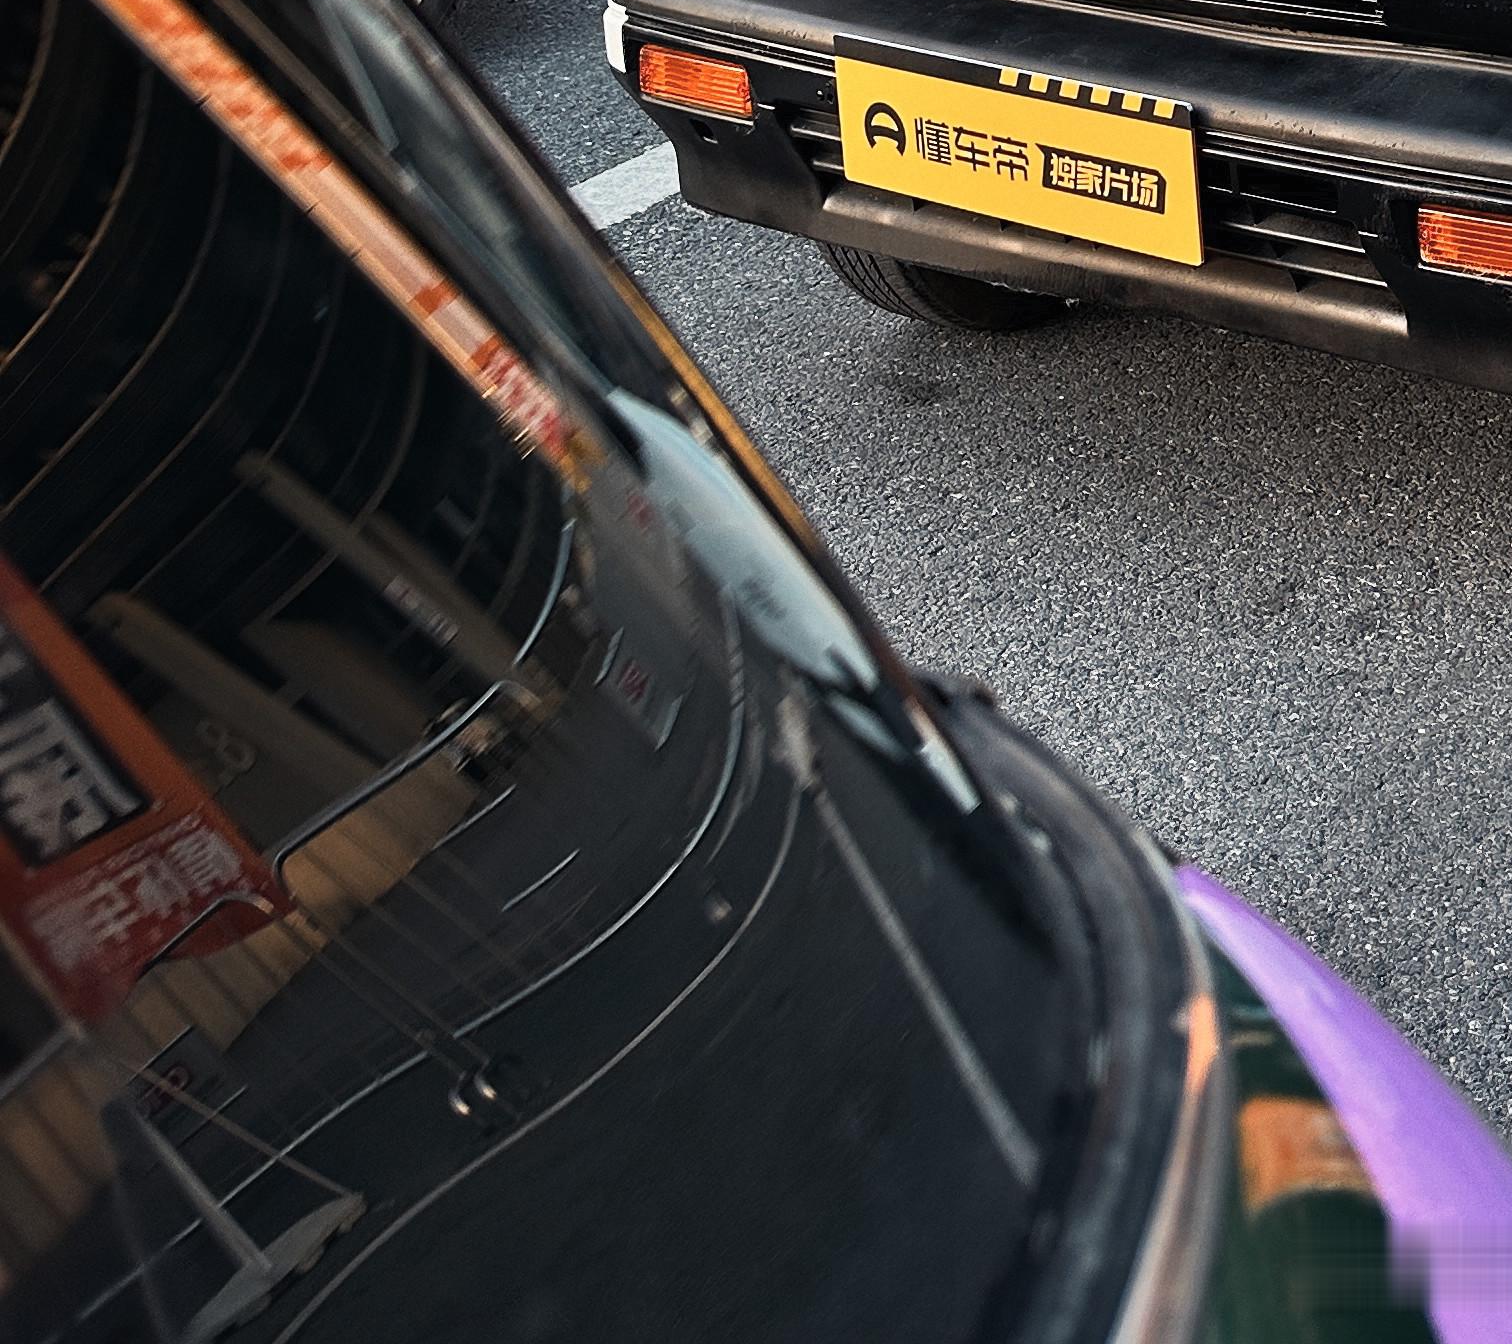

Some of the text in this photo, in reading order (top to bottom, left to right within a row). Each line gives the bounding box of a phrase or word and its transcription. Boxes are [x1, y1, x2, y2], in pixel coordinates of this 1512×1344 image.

[914, 116, 1160, 210] 懂车帝 独家片场
